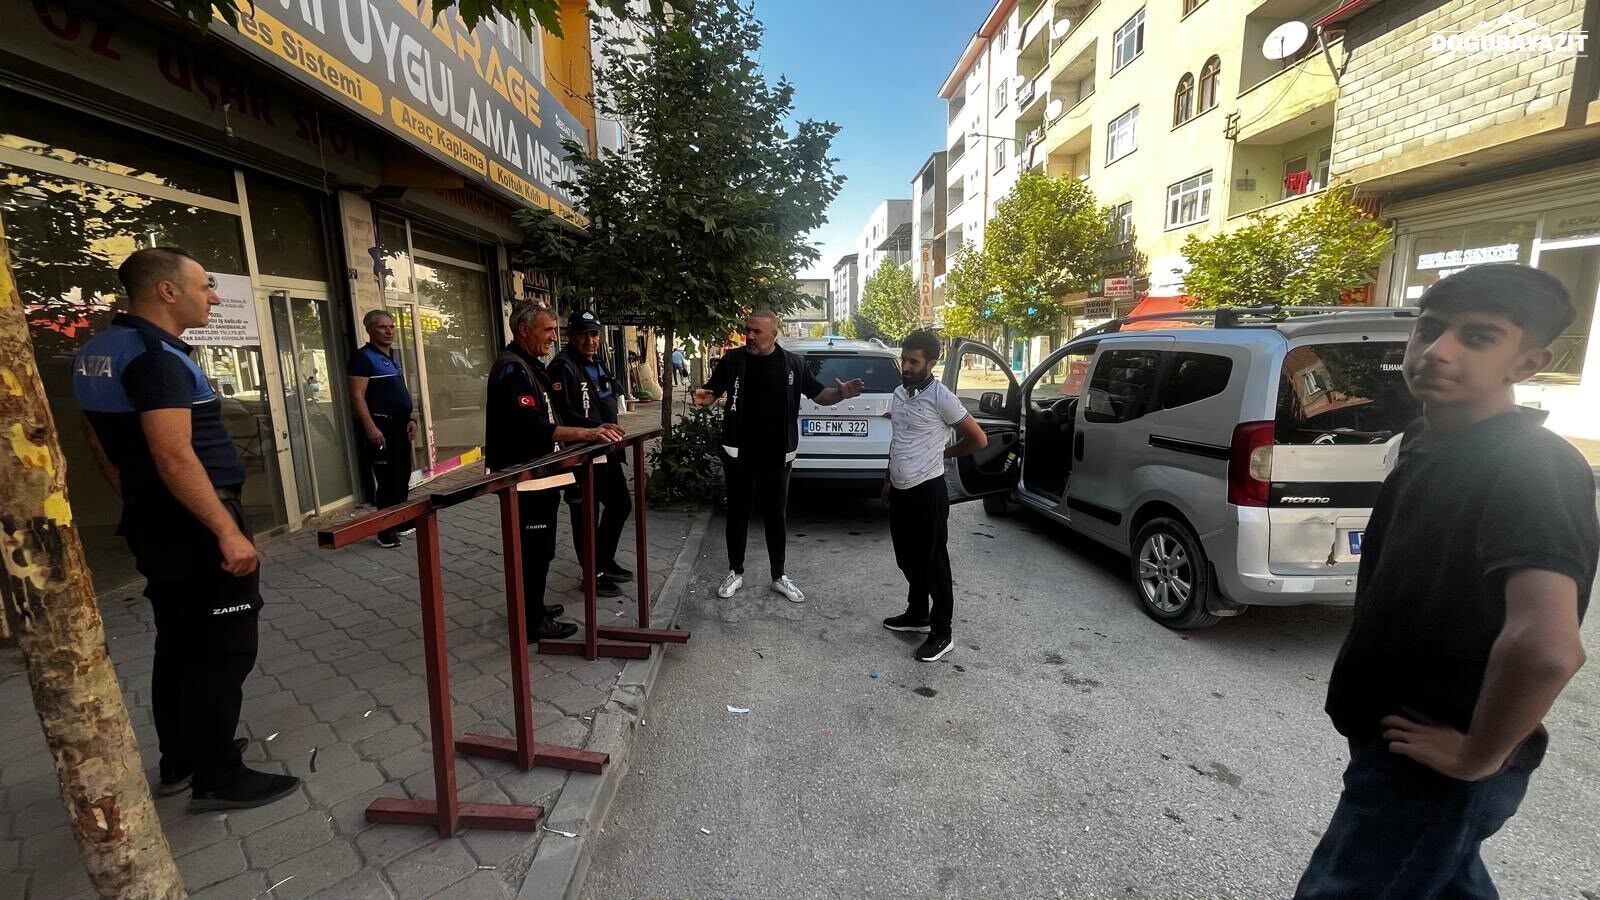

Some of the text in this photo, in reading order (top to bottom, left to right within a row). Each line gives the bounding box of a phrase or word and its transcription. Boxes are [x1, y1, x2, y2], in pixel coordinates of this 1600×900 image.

[238, 10, 274, 46] es
[281, 30, 363, 102] Sistemi
[338, 0, 523, 171] UYGULAMA
[397, 0, 543, 128] ARAGE
[402, 104, 484, 171] Araç Kaplama
[497, 167, 524, 195] Koltuk
[809, 421, 867, 433] 06 FNK 322
[212, 603, 252, 615] ZABITA
